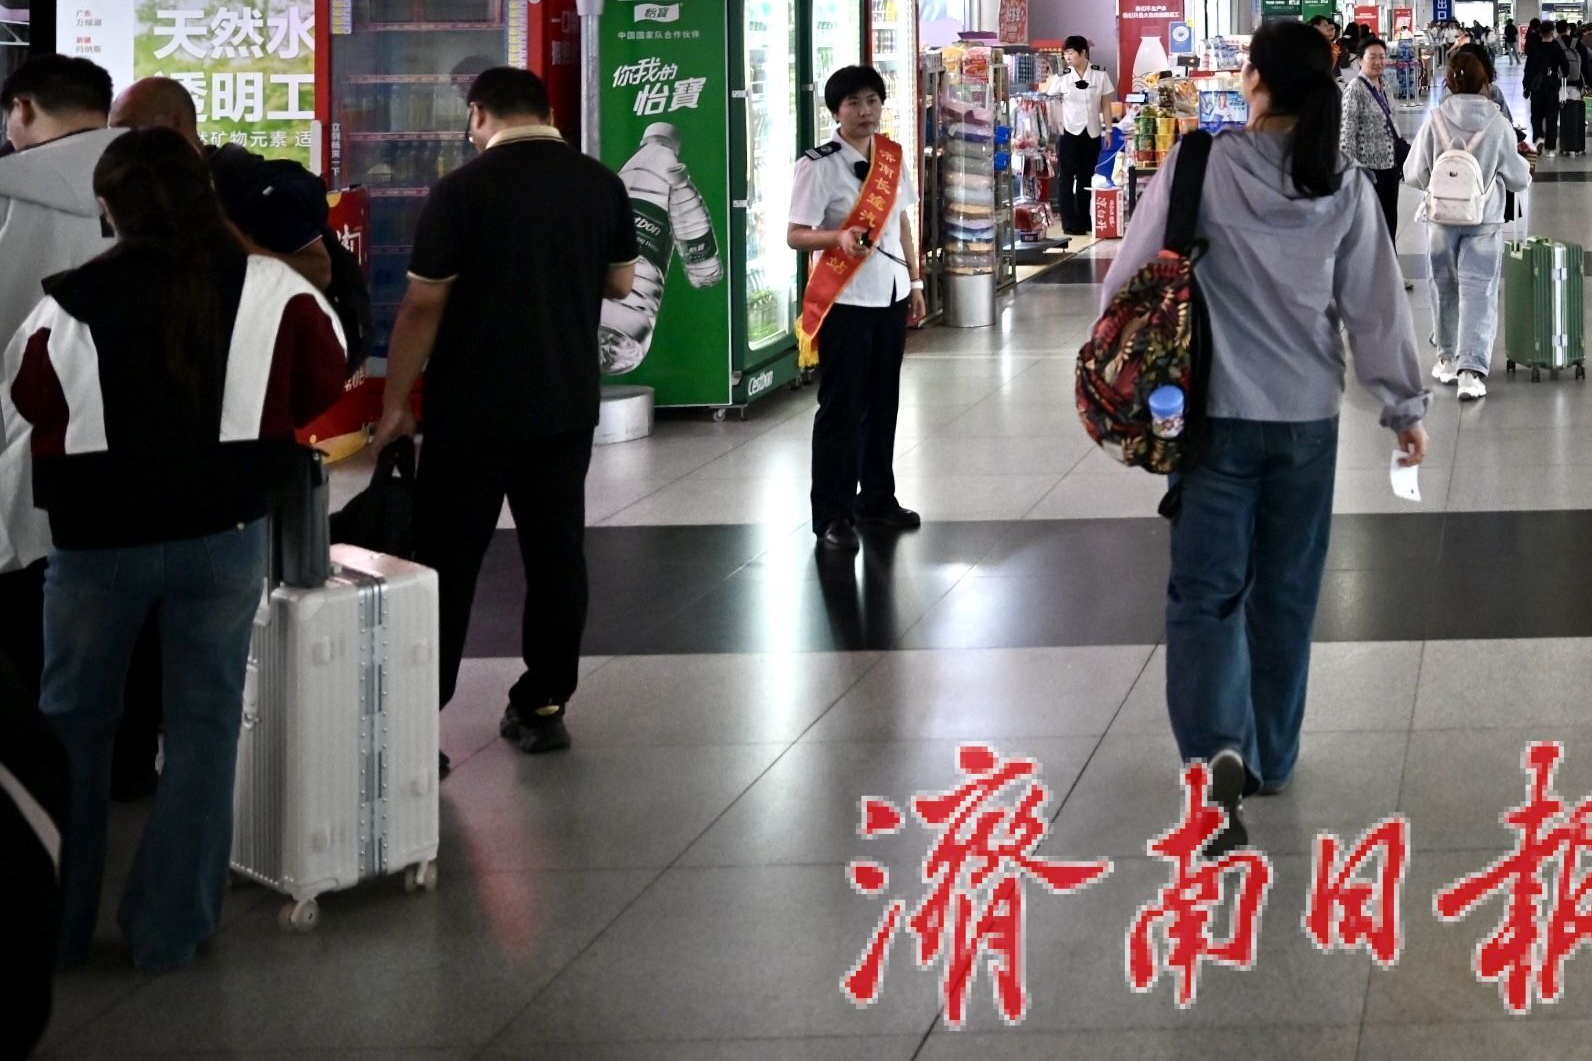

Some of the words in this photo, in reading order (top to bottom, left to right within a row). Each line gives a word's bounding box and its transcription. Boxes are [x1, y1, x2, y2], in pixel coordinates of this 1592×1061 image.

[154, 6, 314, 60] 天然水
[612, 56, 678, 88] 你我的
